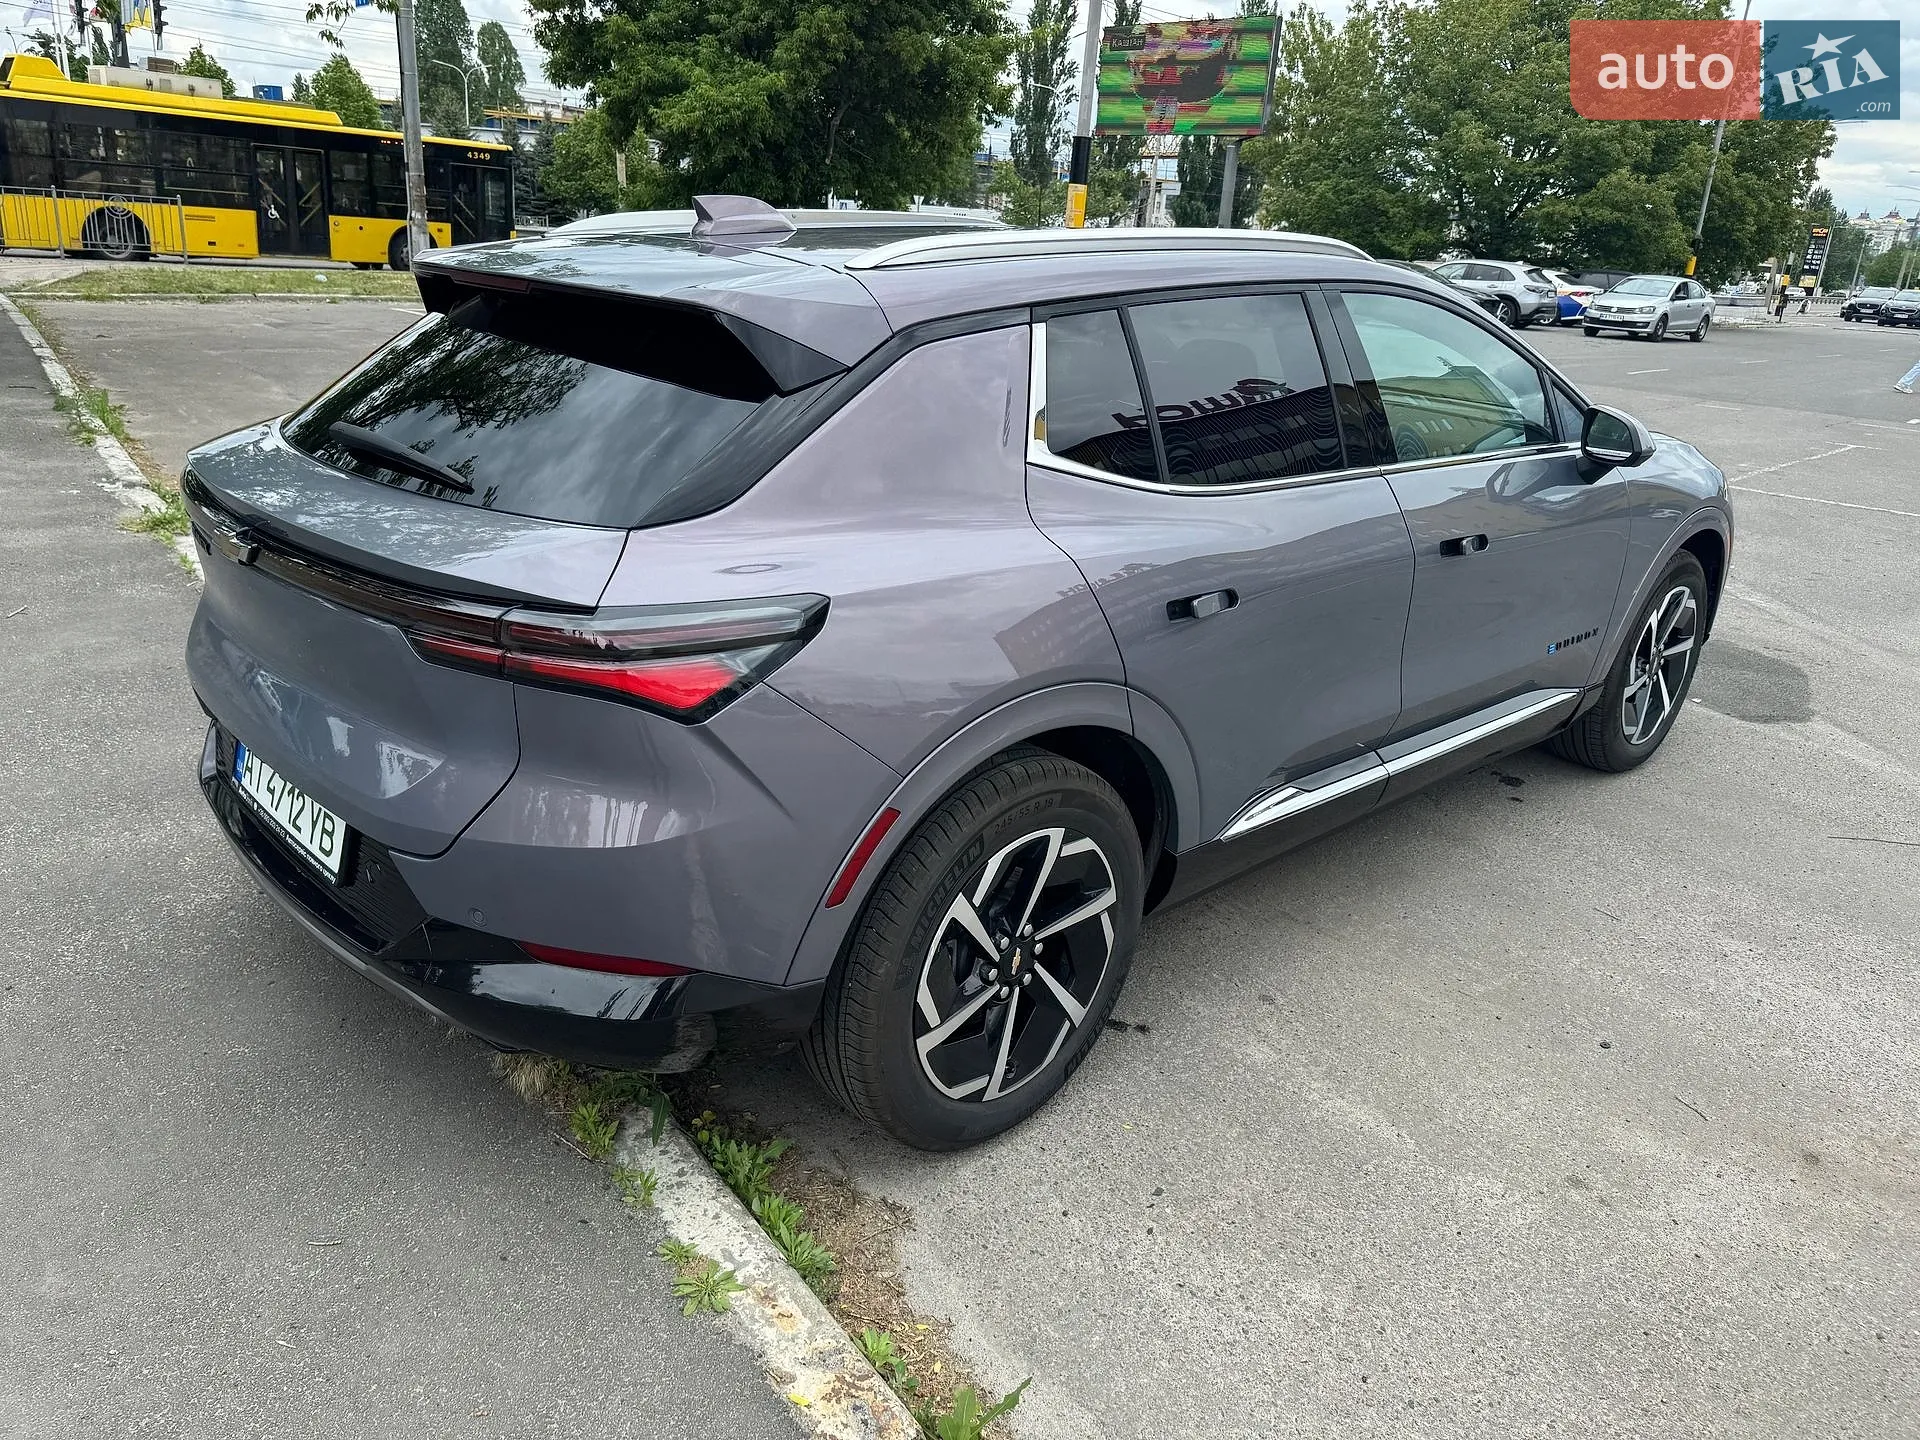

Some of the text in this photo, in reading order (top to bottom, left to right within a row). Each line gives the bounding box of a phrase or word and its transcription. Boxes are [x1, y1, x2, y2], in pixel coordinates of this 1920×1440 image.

[466, 151, 491, 161] 4349
[266, 769, 306, 835] 4712
[309, 799, 336, 858] YB
[911, 842, 983, 952] MICHELIN
